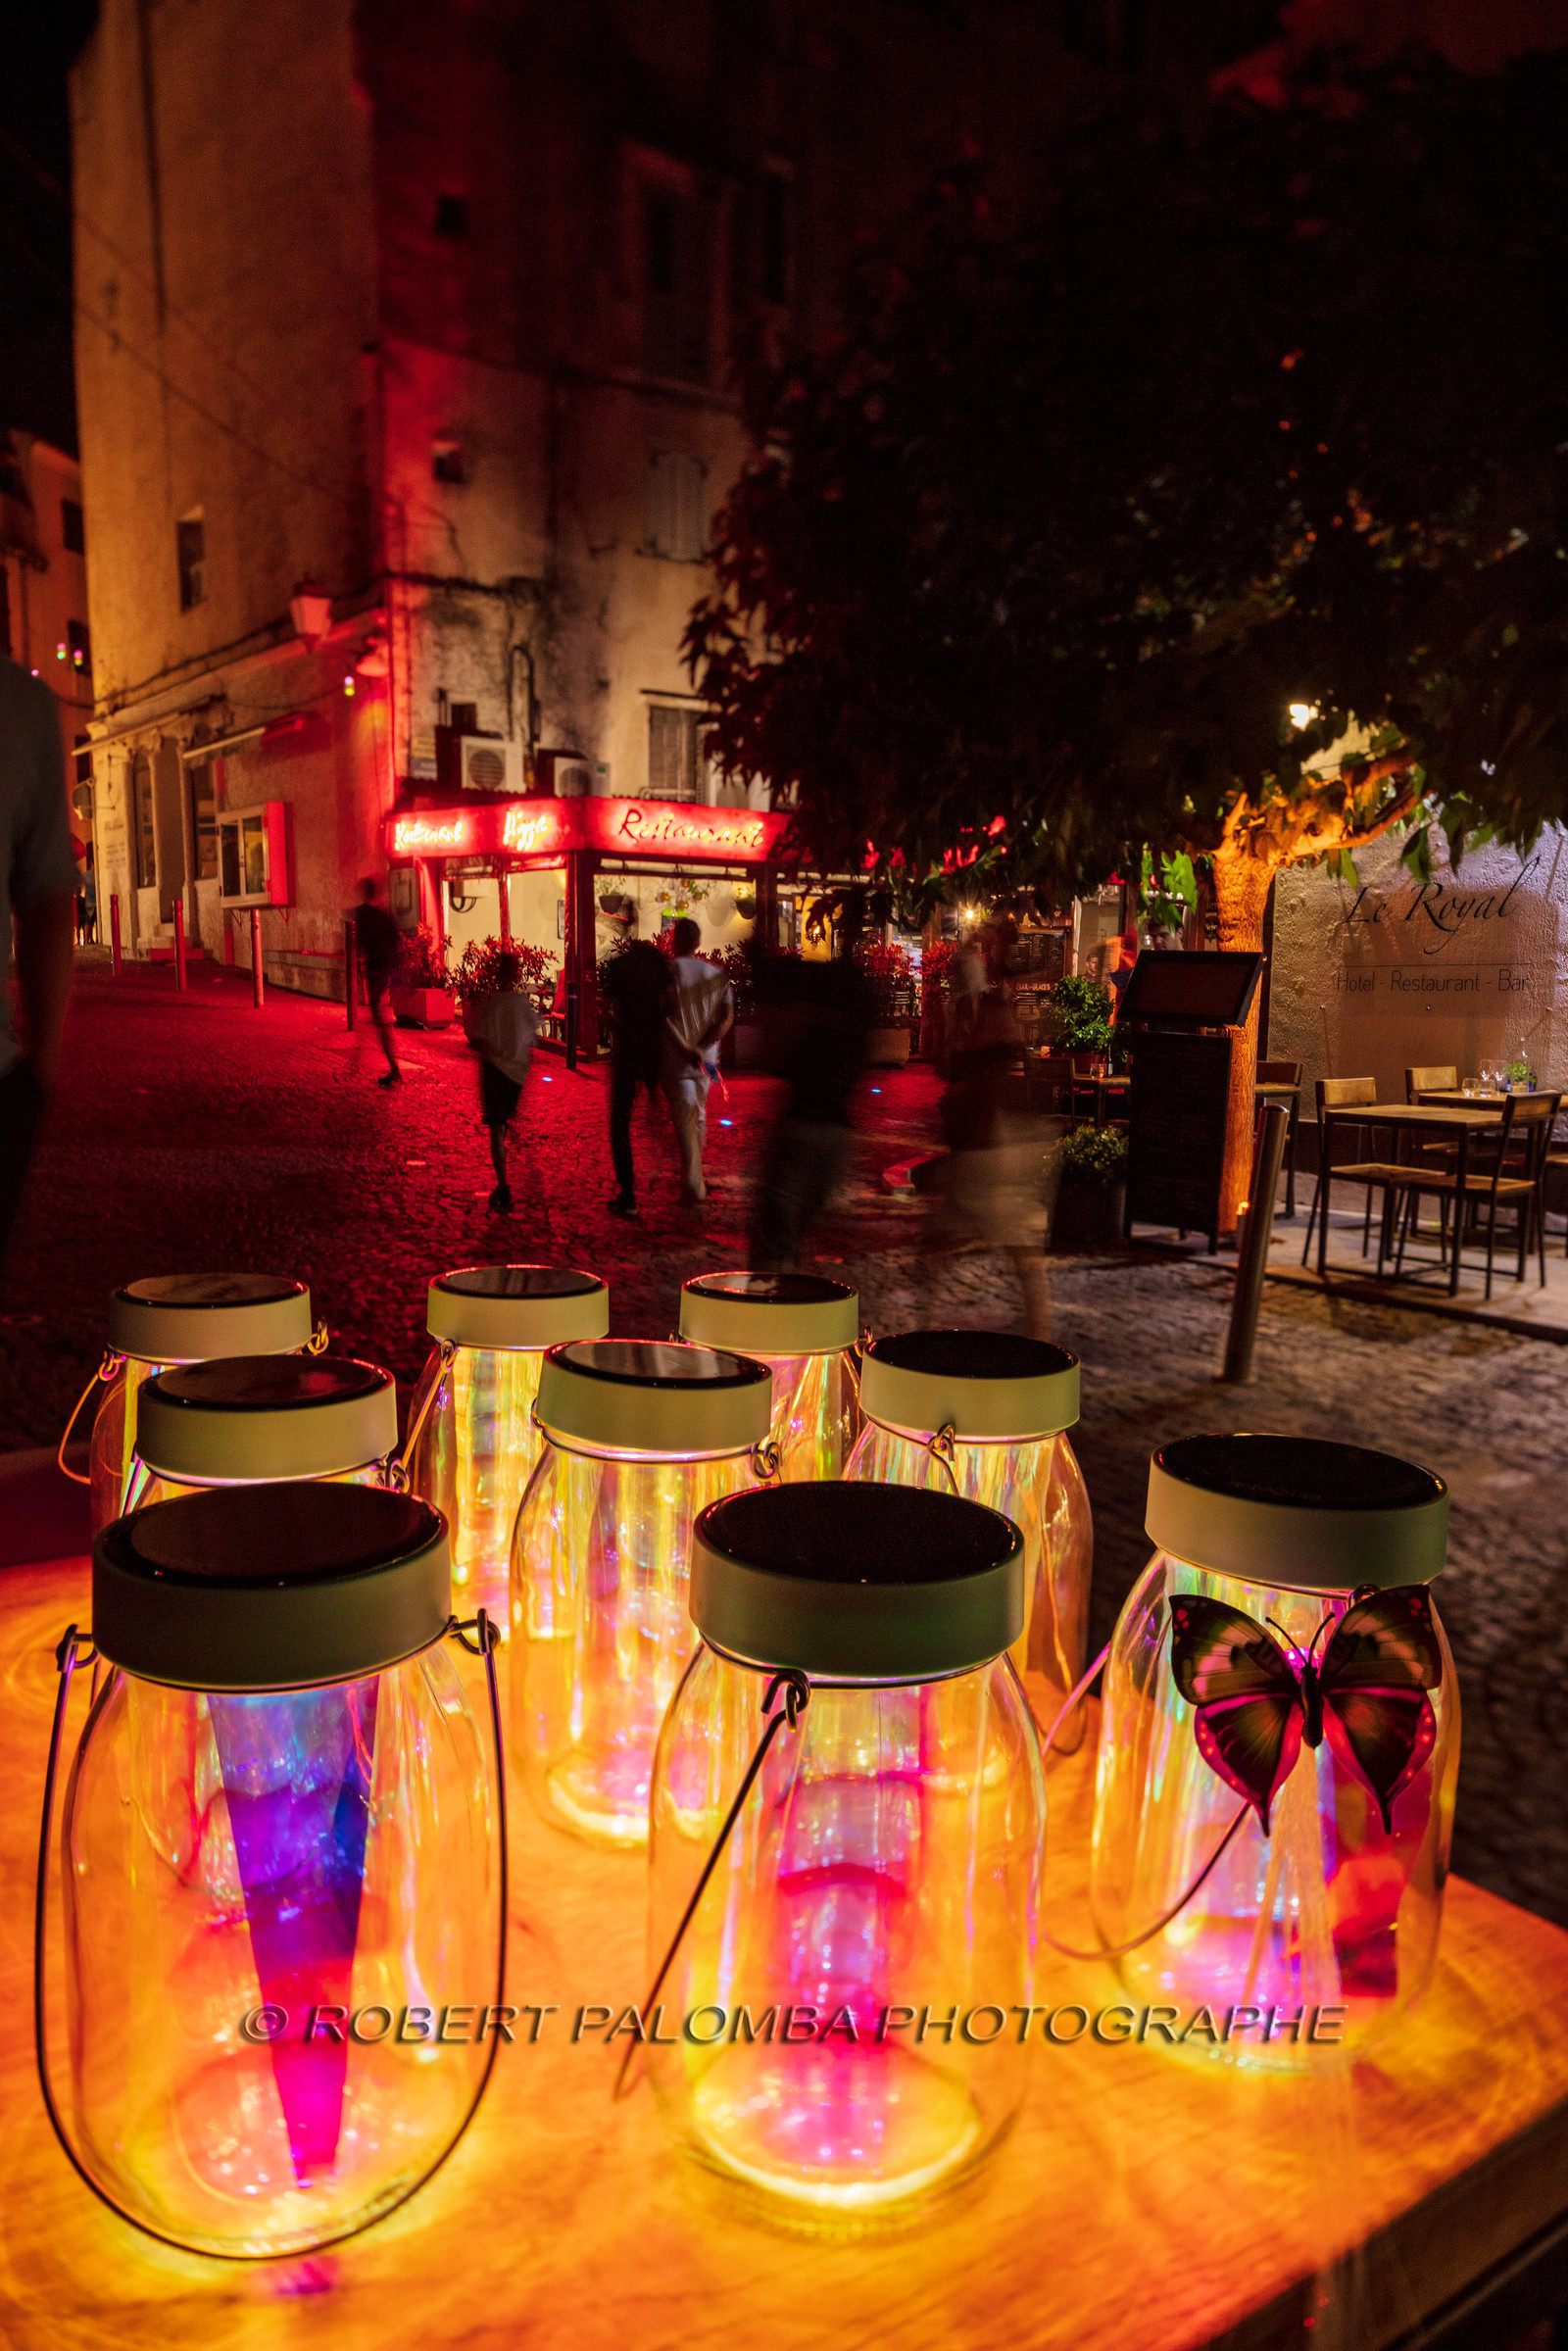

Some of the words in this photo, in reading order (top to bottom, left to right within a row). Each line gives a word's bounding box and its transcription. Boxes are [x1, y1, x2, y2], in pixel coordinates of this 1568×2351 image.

[618, 808, 764, 849] Restaurant
[1341, 886, 1391, 924] Le
[1404, 856, 1542, 955] Royal
[1337, 970, 1376, 993] Hotel
[1390, 969, 1481, 993] Restaurant
[1497, 968, 1530, 992] Bar
